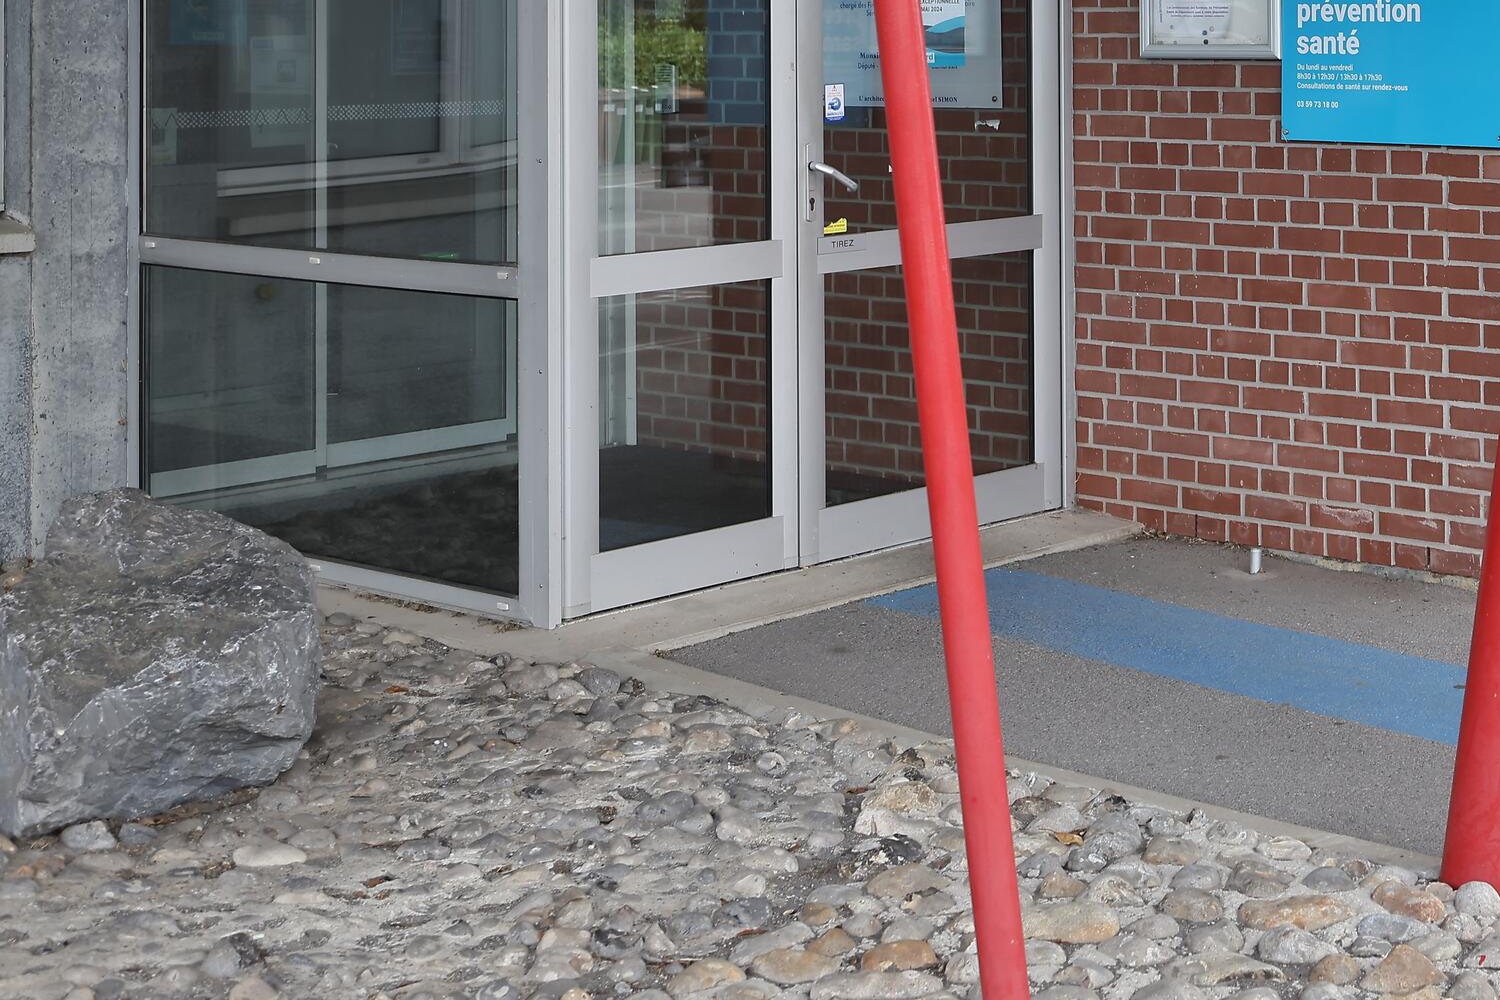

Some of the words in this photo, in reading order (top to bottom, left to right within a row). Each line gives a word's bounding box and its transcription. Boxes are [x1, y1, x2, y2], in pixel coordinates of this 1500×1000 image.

[1296, 29, 1360, 55] santé
[1296, 63, 1305, 71] Du
[1305, 63, 1320, 71] lundi
[1328, 63, 1354, 71] vendredi
[1296, 72, 1311, 80] 8h30
[1317, 73, 1335, 81] 12h30
[1340, 73, 1358, 81] 13h30
[1364, 73, 1383, 81] 17h30
[1296, 81, 1336, 90] Consultations
[1344, 82, 1361, 91] santé
[1372, 83, 1409, 91] rendez-vous
[1296, 100, 1305, 108] 03
[1305, 100, 1313, 108] 59
[1330, 101, 1339, 109] 00
[831, 239, 855, 248] TIREZ
